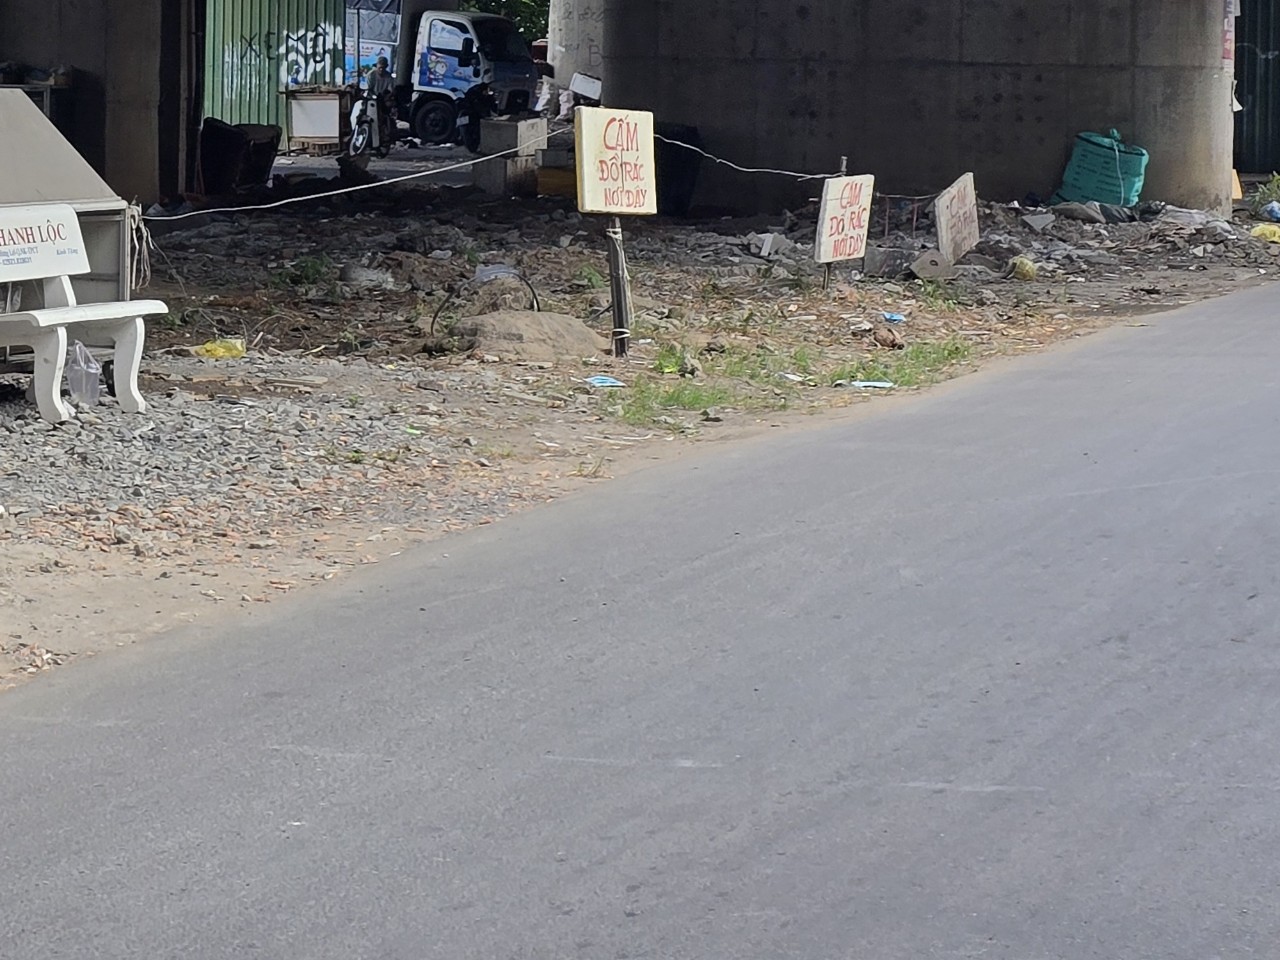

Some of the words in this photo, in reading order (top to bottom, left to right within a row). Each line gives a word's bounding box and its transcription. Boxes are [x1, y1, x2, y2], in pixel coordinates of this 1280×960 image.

[604, 114, 639, 152] CẤM
[623, 155, 645, 182] RÁC
[38, 219, 68, 246] LỘC
